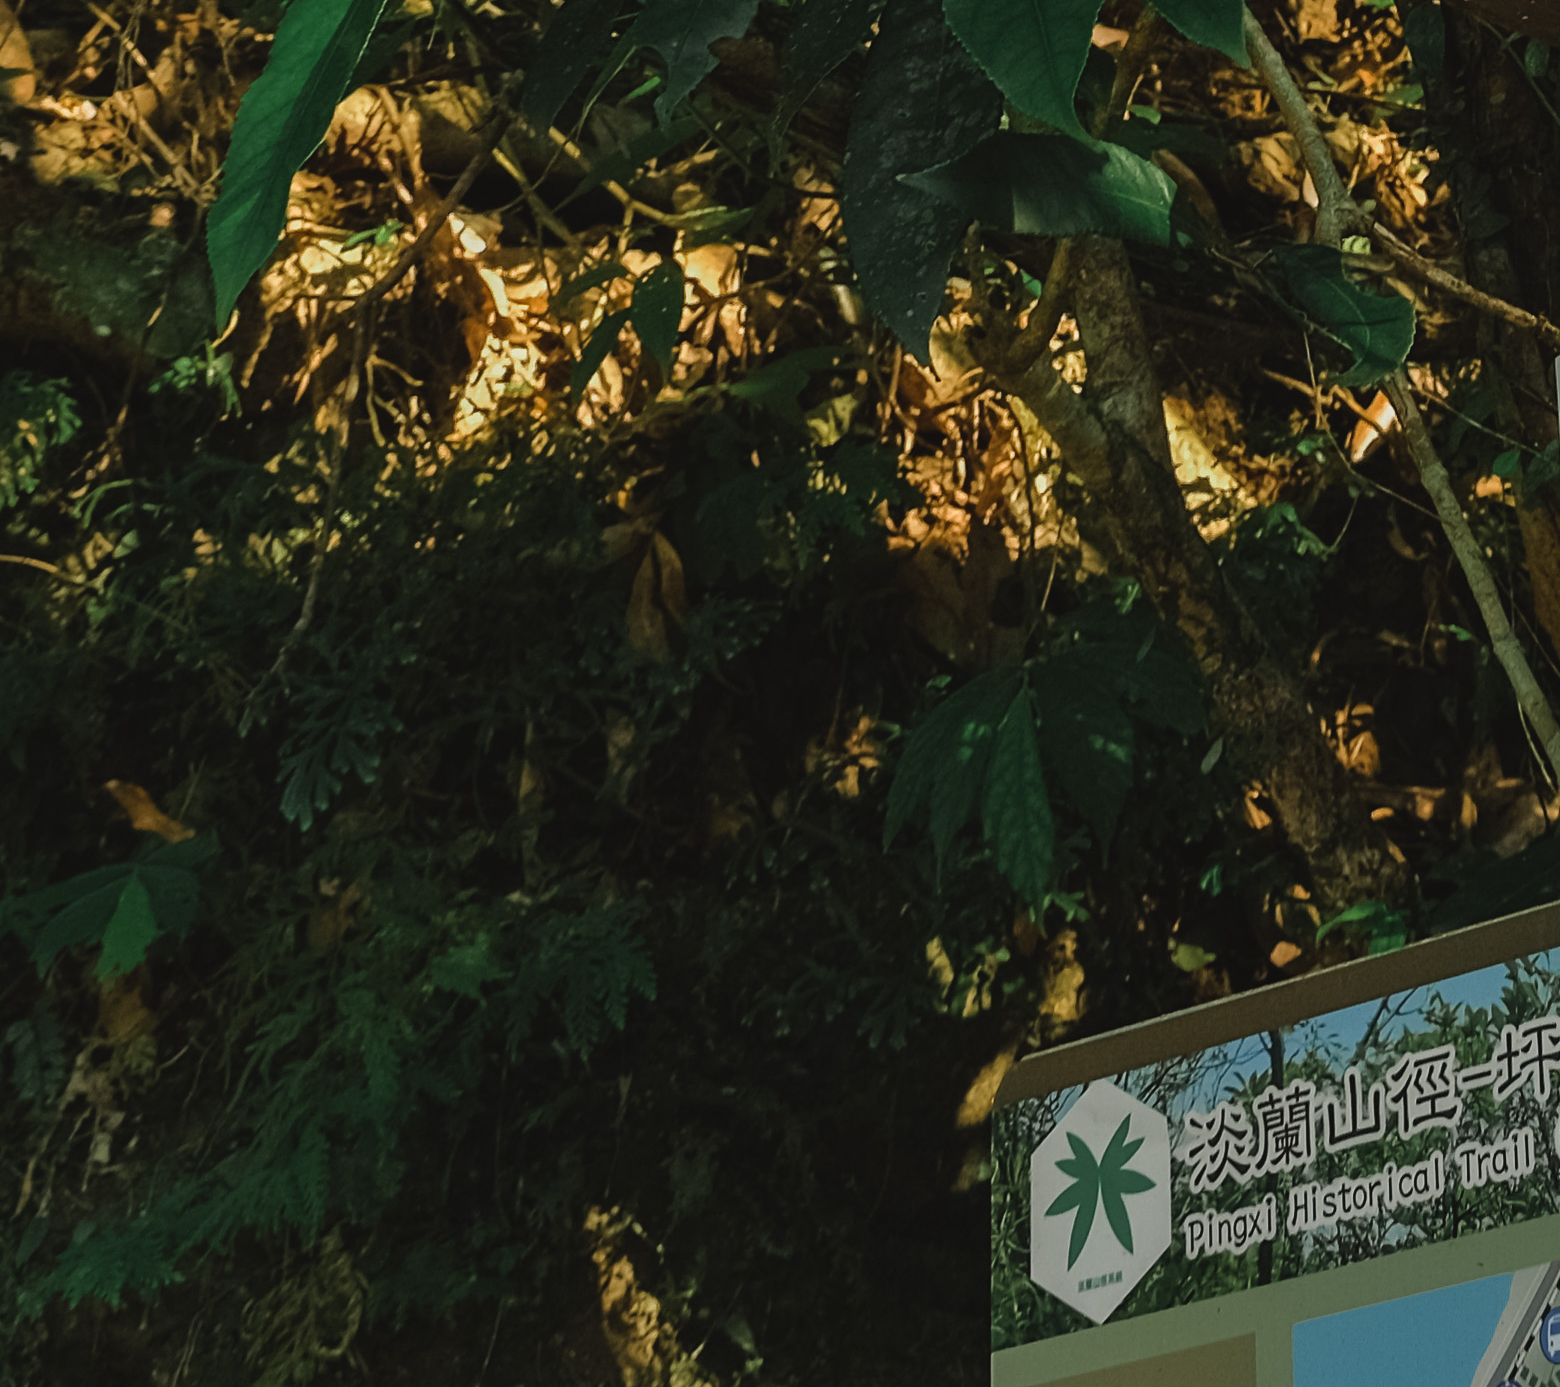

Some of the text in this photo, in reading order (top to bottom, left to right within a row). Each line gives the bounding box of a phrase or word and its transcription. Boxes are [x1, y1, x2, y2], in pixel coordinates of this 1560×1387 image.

[1187, 1195, 1274, 1253] Pingxi
[1290, 1155, 1441, 1227] Historical
[1459, 1130, 1532, 1182] Trail
